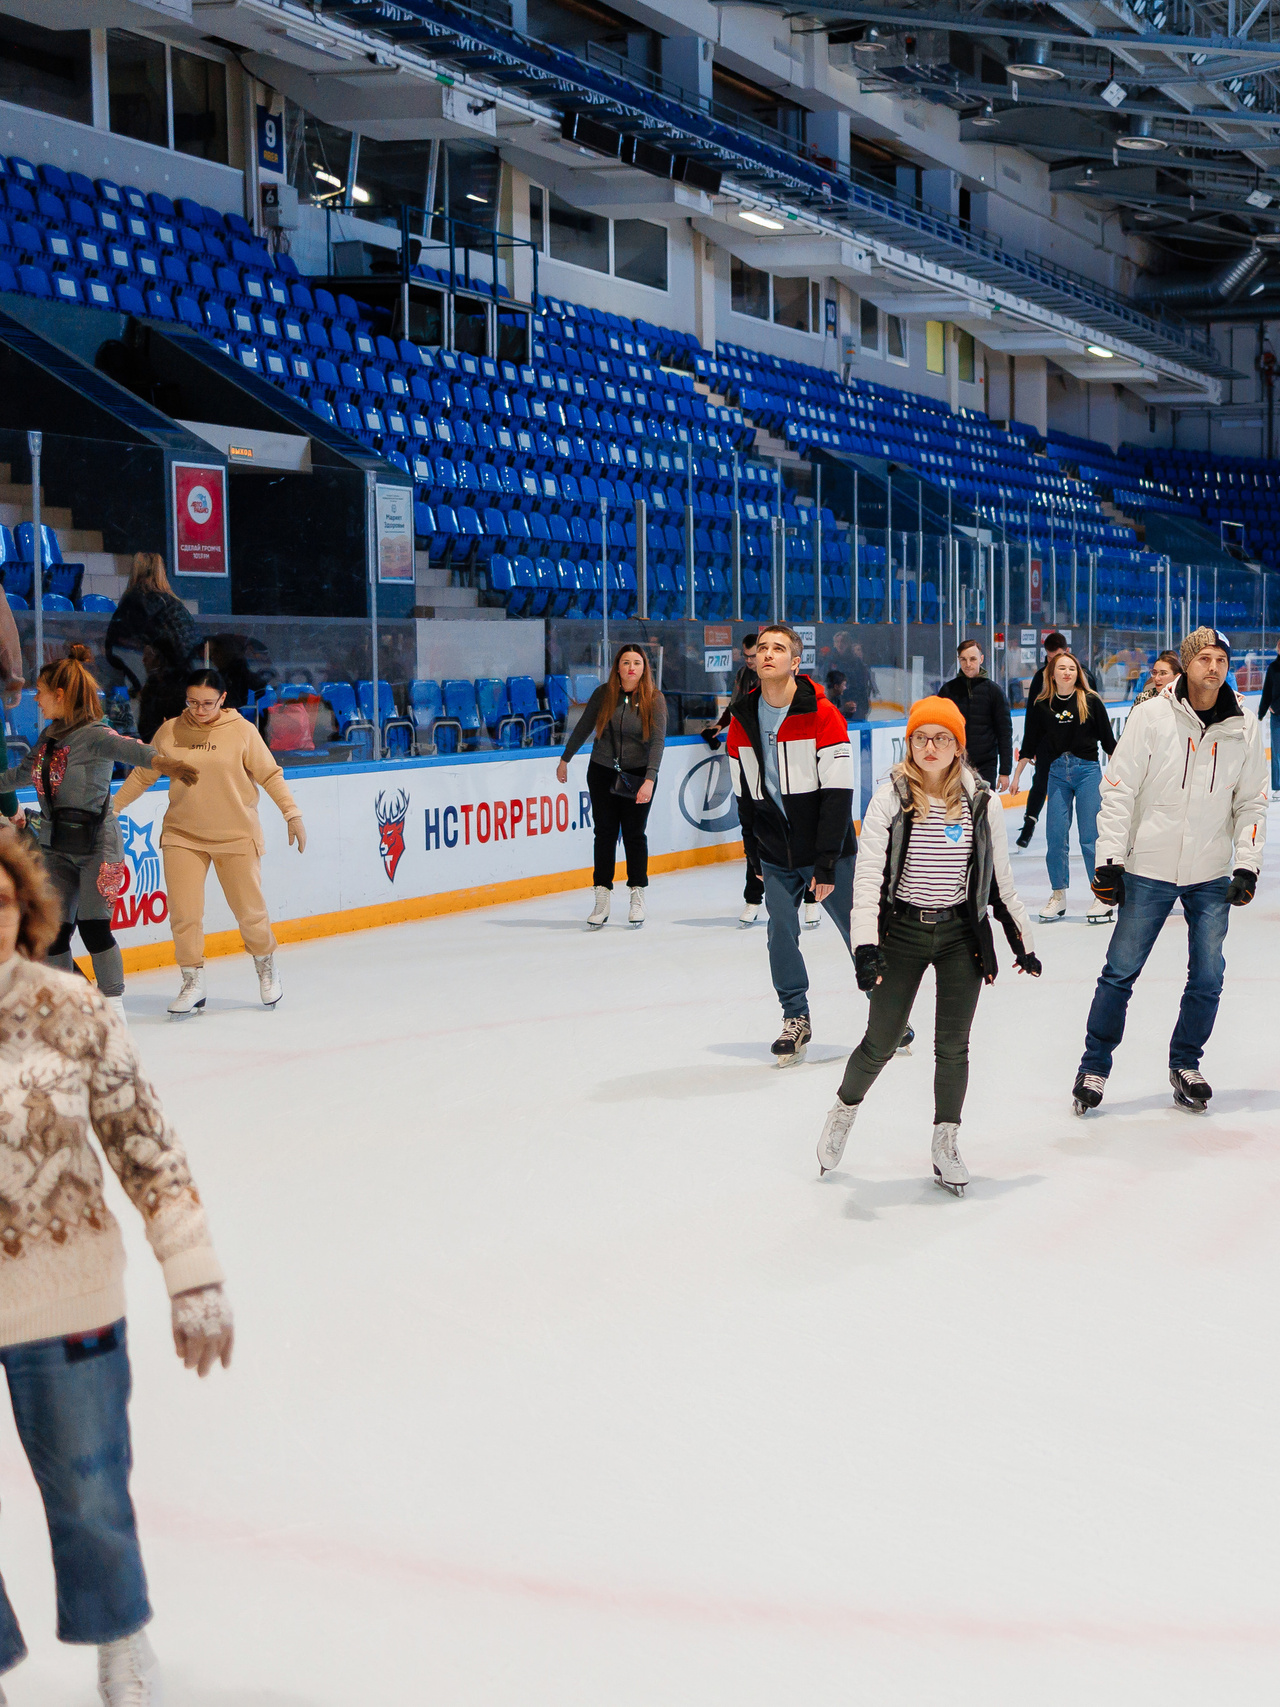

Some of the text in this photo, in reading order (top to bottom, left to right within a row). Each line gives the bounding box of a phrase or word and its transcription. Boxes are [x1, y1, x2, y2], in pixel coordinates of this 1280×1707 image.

[265, 119, 277, 148] 9
[266, 190, 275, 204] 6
[231, 447, 253, 457] ВЫХОД
[425, 791, 592, 851] HCTORPEDO.R
[110, 891, 168, 930] ДИО
